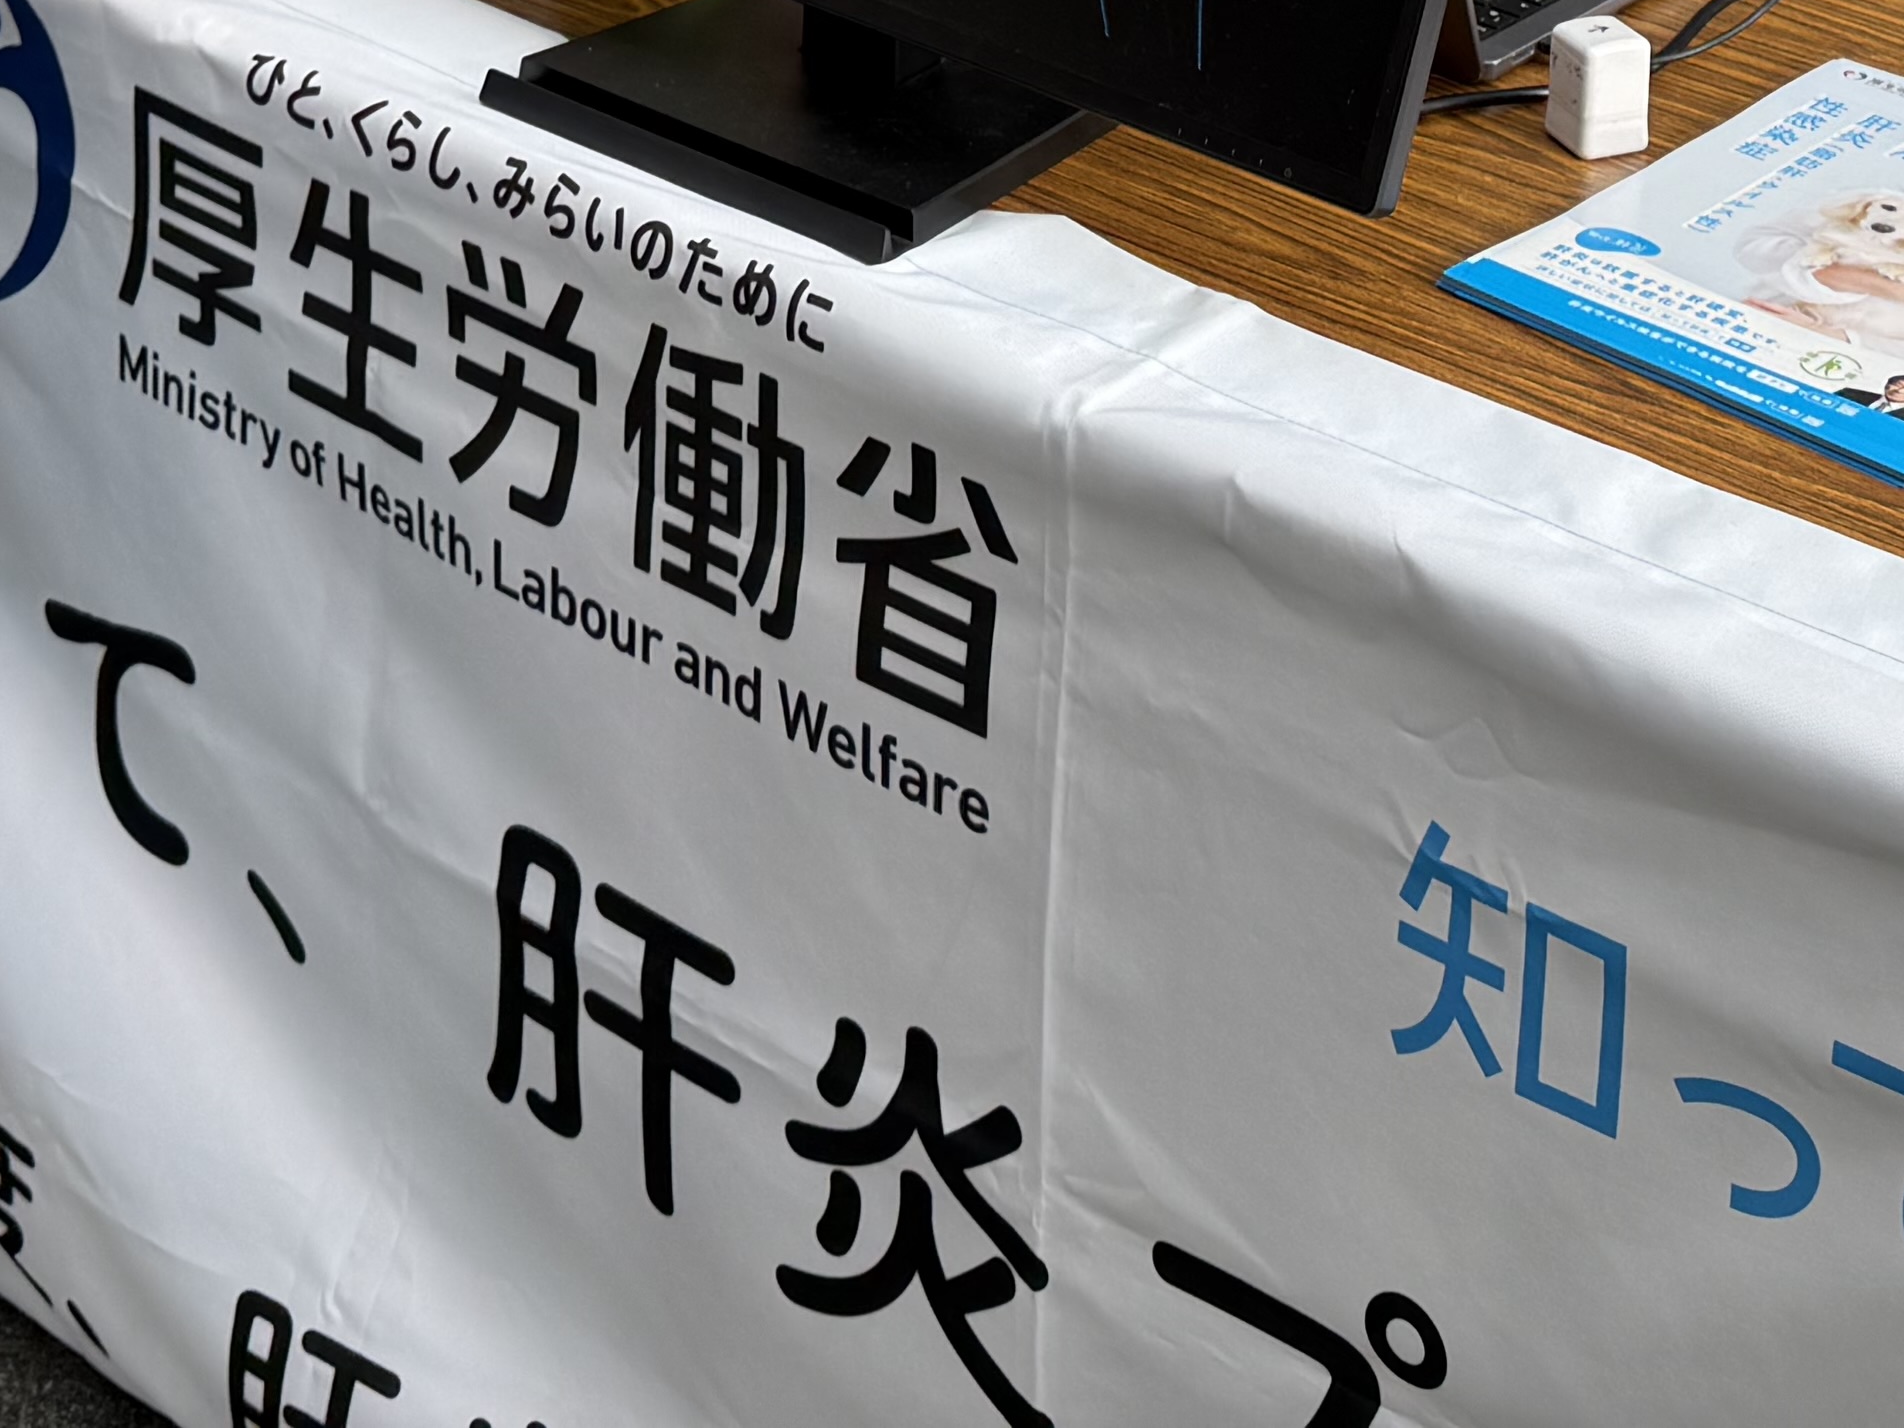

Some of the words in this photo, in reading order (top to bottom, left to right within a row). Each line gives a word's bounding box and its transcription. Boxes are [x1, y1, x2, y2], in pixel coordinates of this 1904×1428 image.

[242, 50, 836, 355] ひと、くらし、みらいのために
[1734, 95, 1849, 162] 性感染症
[116, 84, 1022, 740] 厚生労働省
[116, 332, 283, 472] Ministry
[287, 438, 330, 490] of
[336, 458, 485, 590] Health,
[494, 537, 665, 670] Labour
[673, 634, 765, 723] and
[777, 676, 992, 837] Welfare
